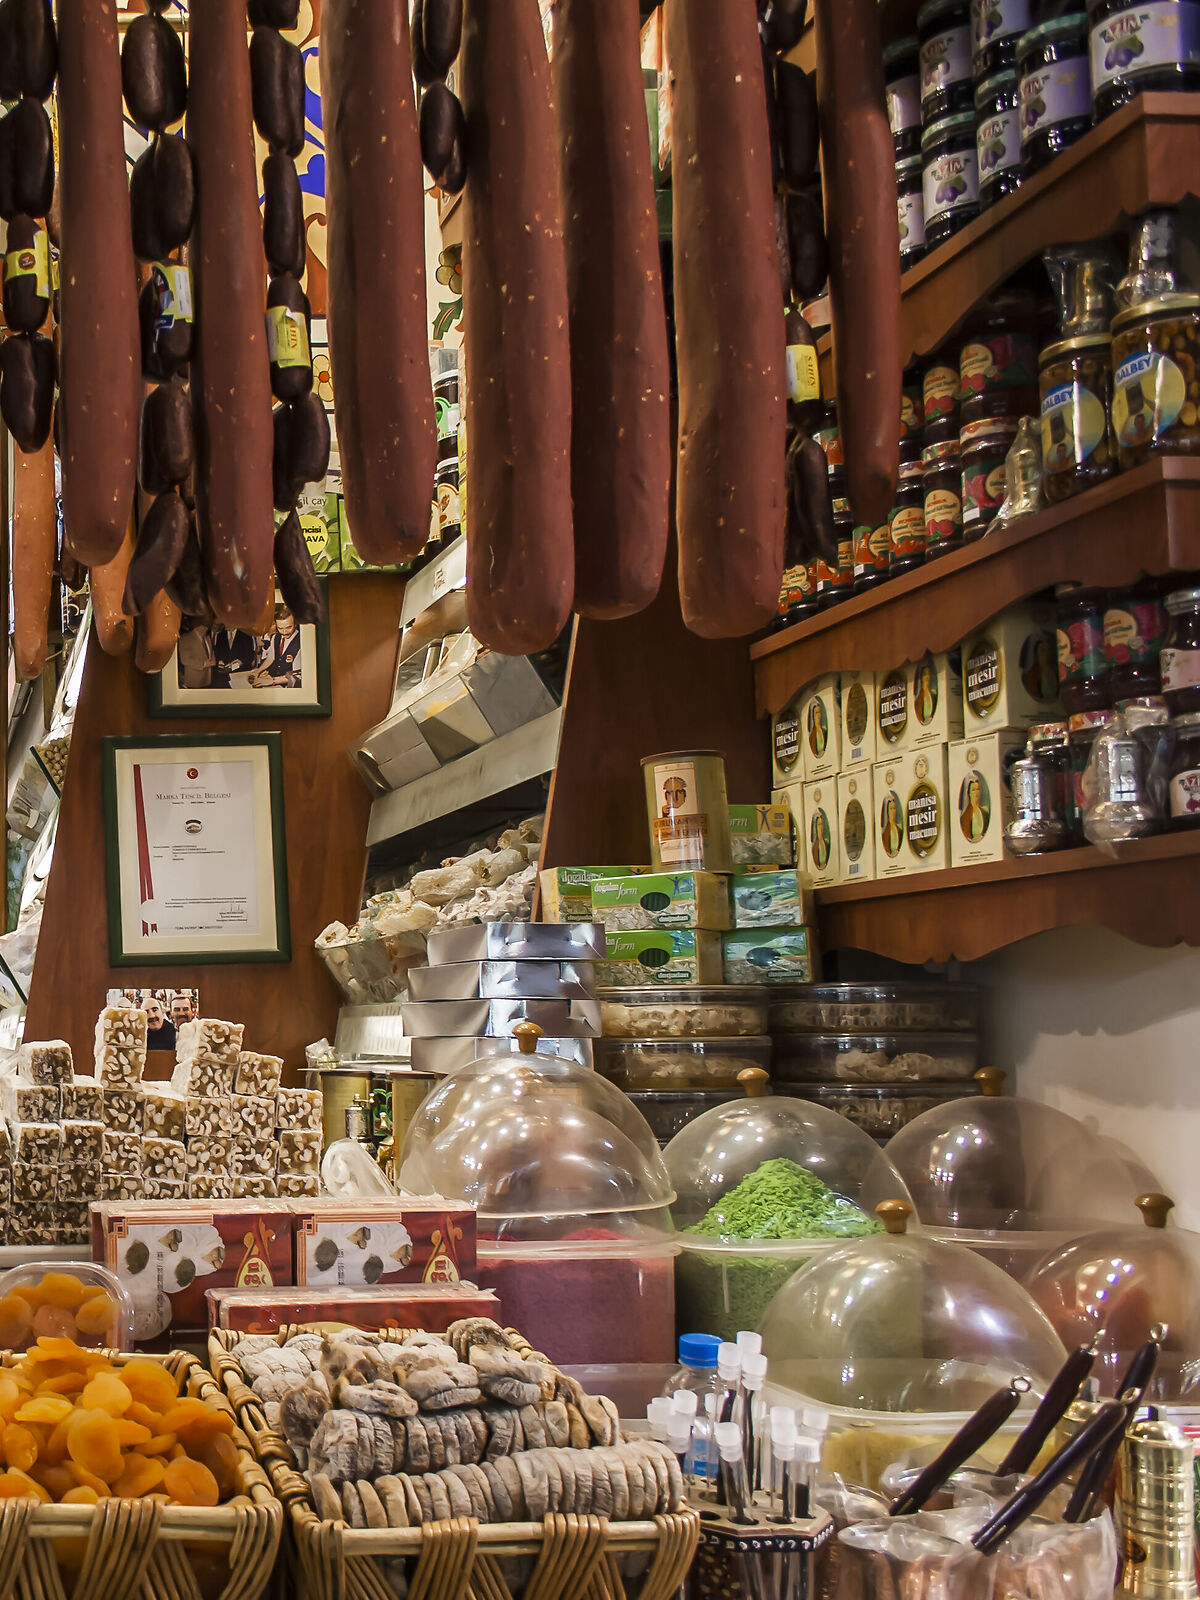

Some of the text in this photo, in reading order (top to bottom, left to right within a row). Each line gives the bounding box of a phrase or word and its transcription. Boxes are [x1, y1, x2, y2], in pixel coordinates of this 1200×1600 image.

[968, 662, 998, 687] mesir
[881, 695, 906, 714] mesir
[909, 806, 937, 827] mesir
[616, 882, 638, 900] form
[611, 937, 635, 954] form
